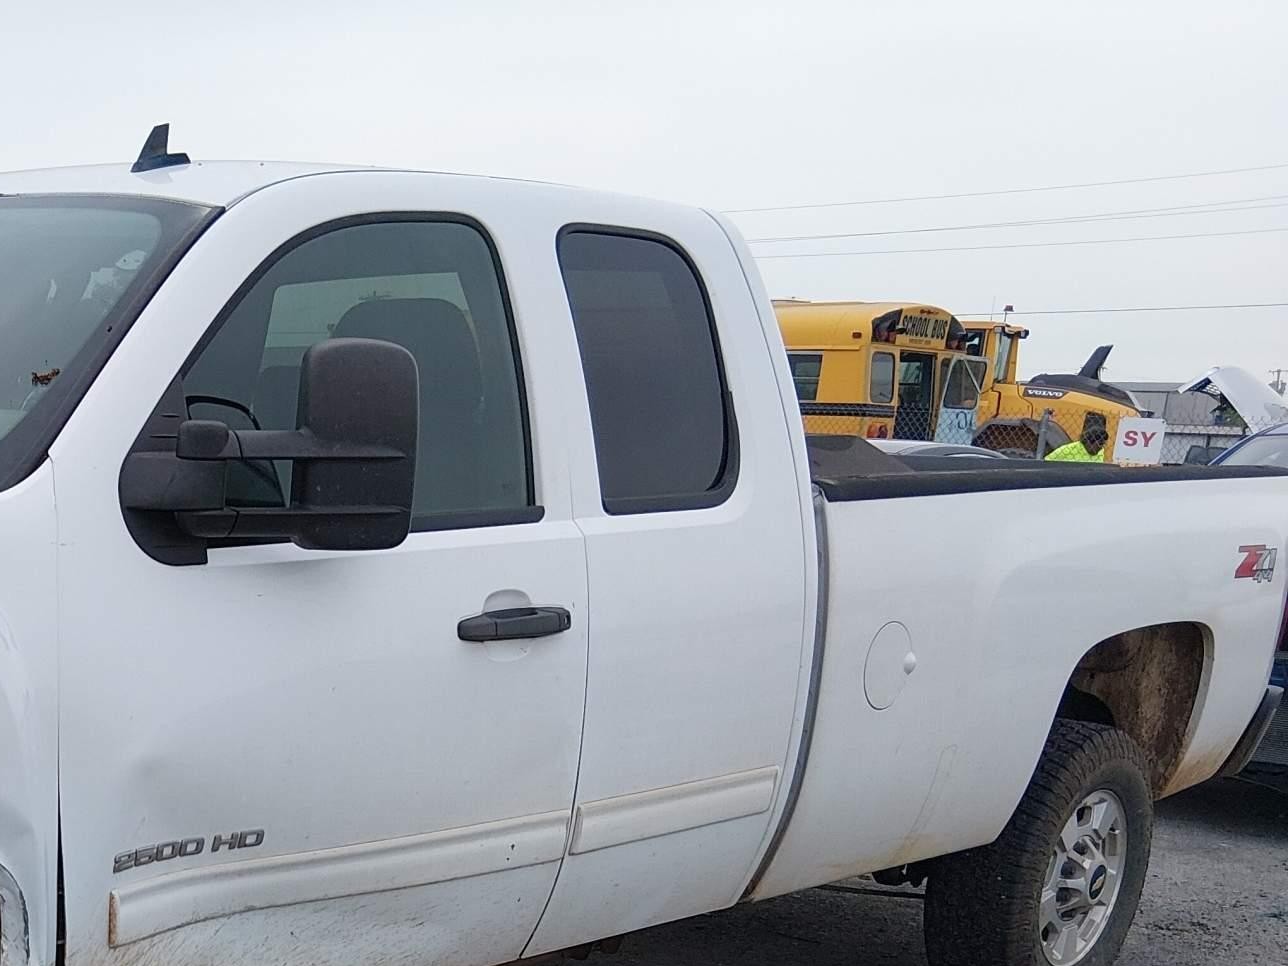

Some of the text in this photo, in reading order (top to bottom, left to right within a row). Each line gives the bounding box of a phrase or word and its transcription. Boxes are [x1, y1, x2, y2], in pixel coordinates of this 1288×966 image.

[902, 314, 948, 340] SCHOOL BUS
[1026, 388, 1064, 398] VOLVO
[1123, 430, 1157, 448] SY
[1234, 544, 1278, 579] Z71
[112, 829, 265, 874] 2500 HD
